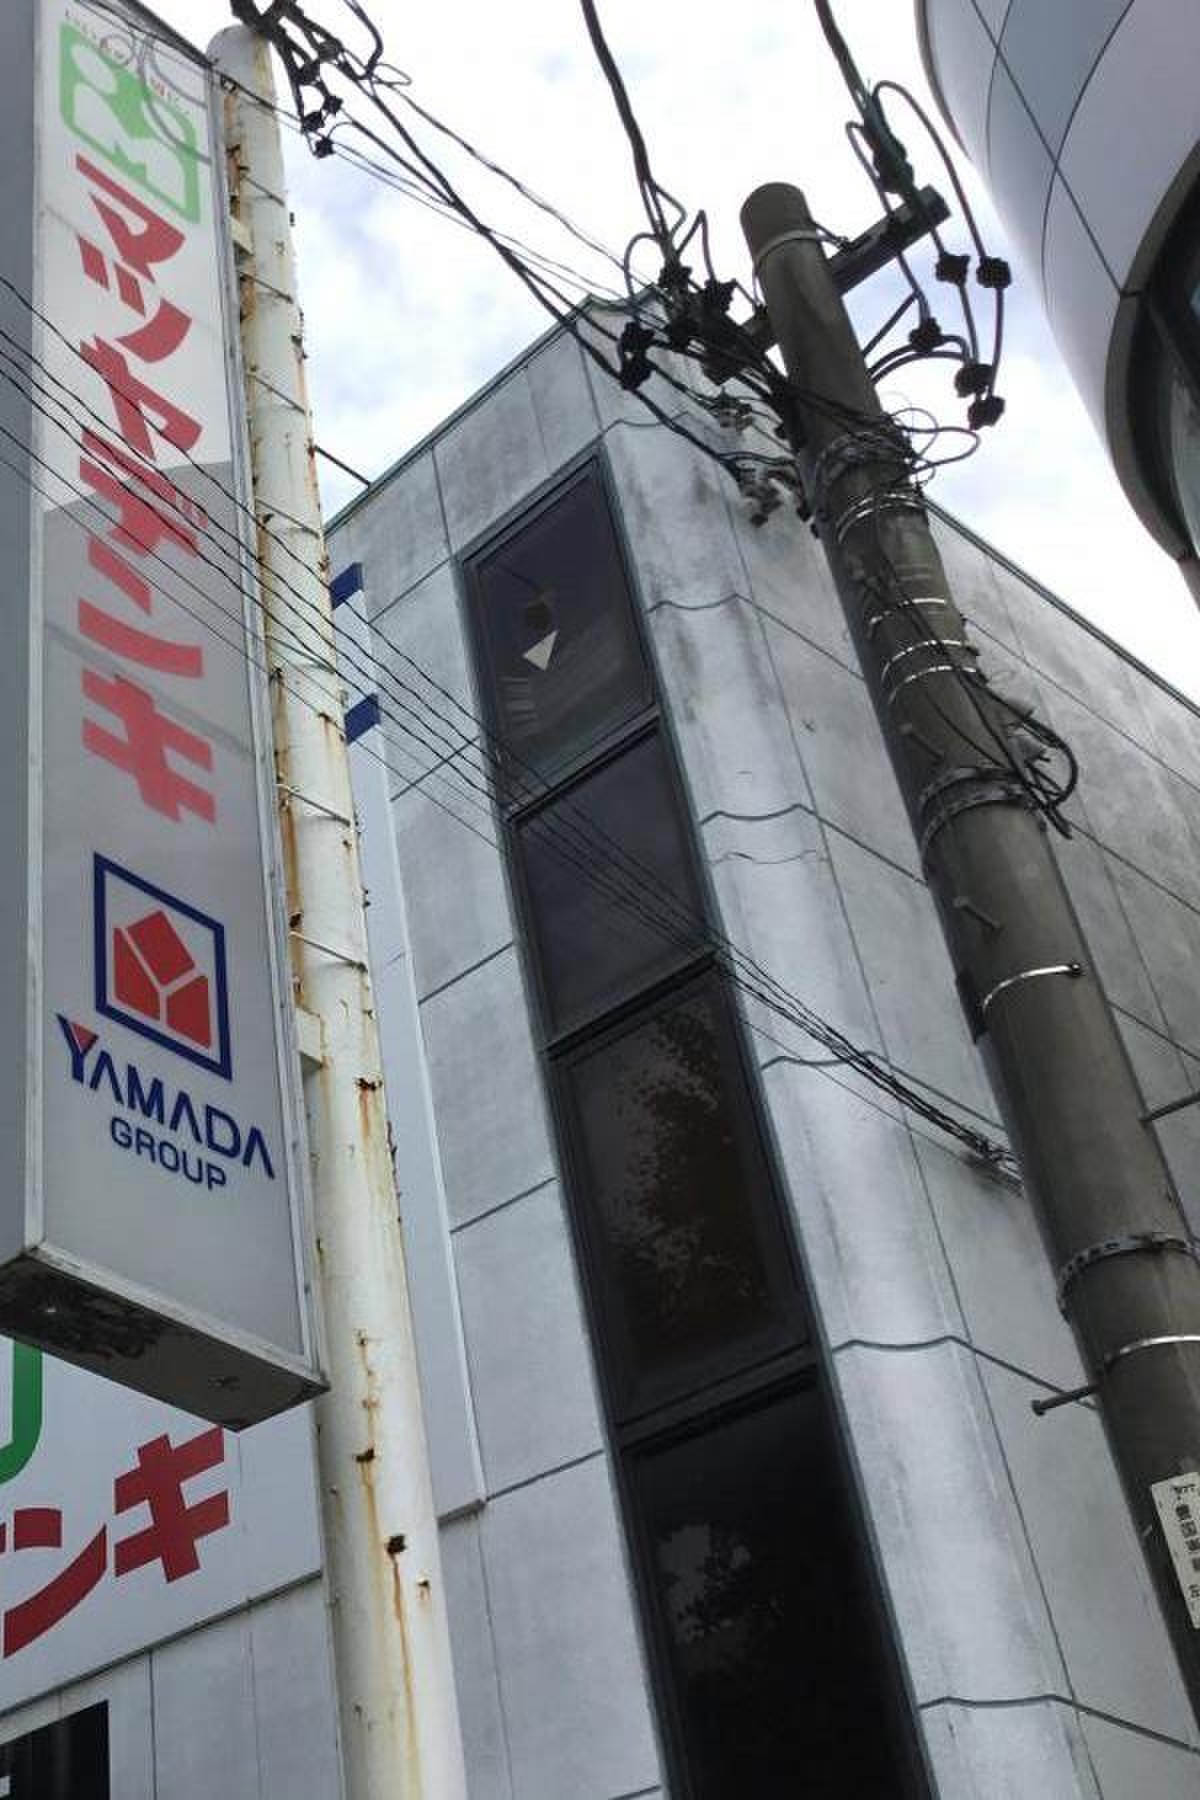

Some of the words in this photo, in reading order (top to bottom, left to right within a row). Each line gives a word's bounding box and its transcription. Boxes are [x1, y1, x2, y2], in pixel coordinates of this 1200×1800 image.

[75, 153, 218, 825] マツヤデンキ
[57, 1013, 276, 1180] YAMADA
[110, 1116, 227, 1190] GROUP
